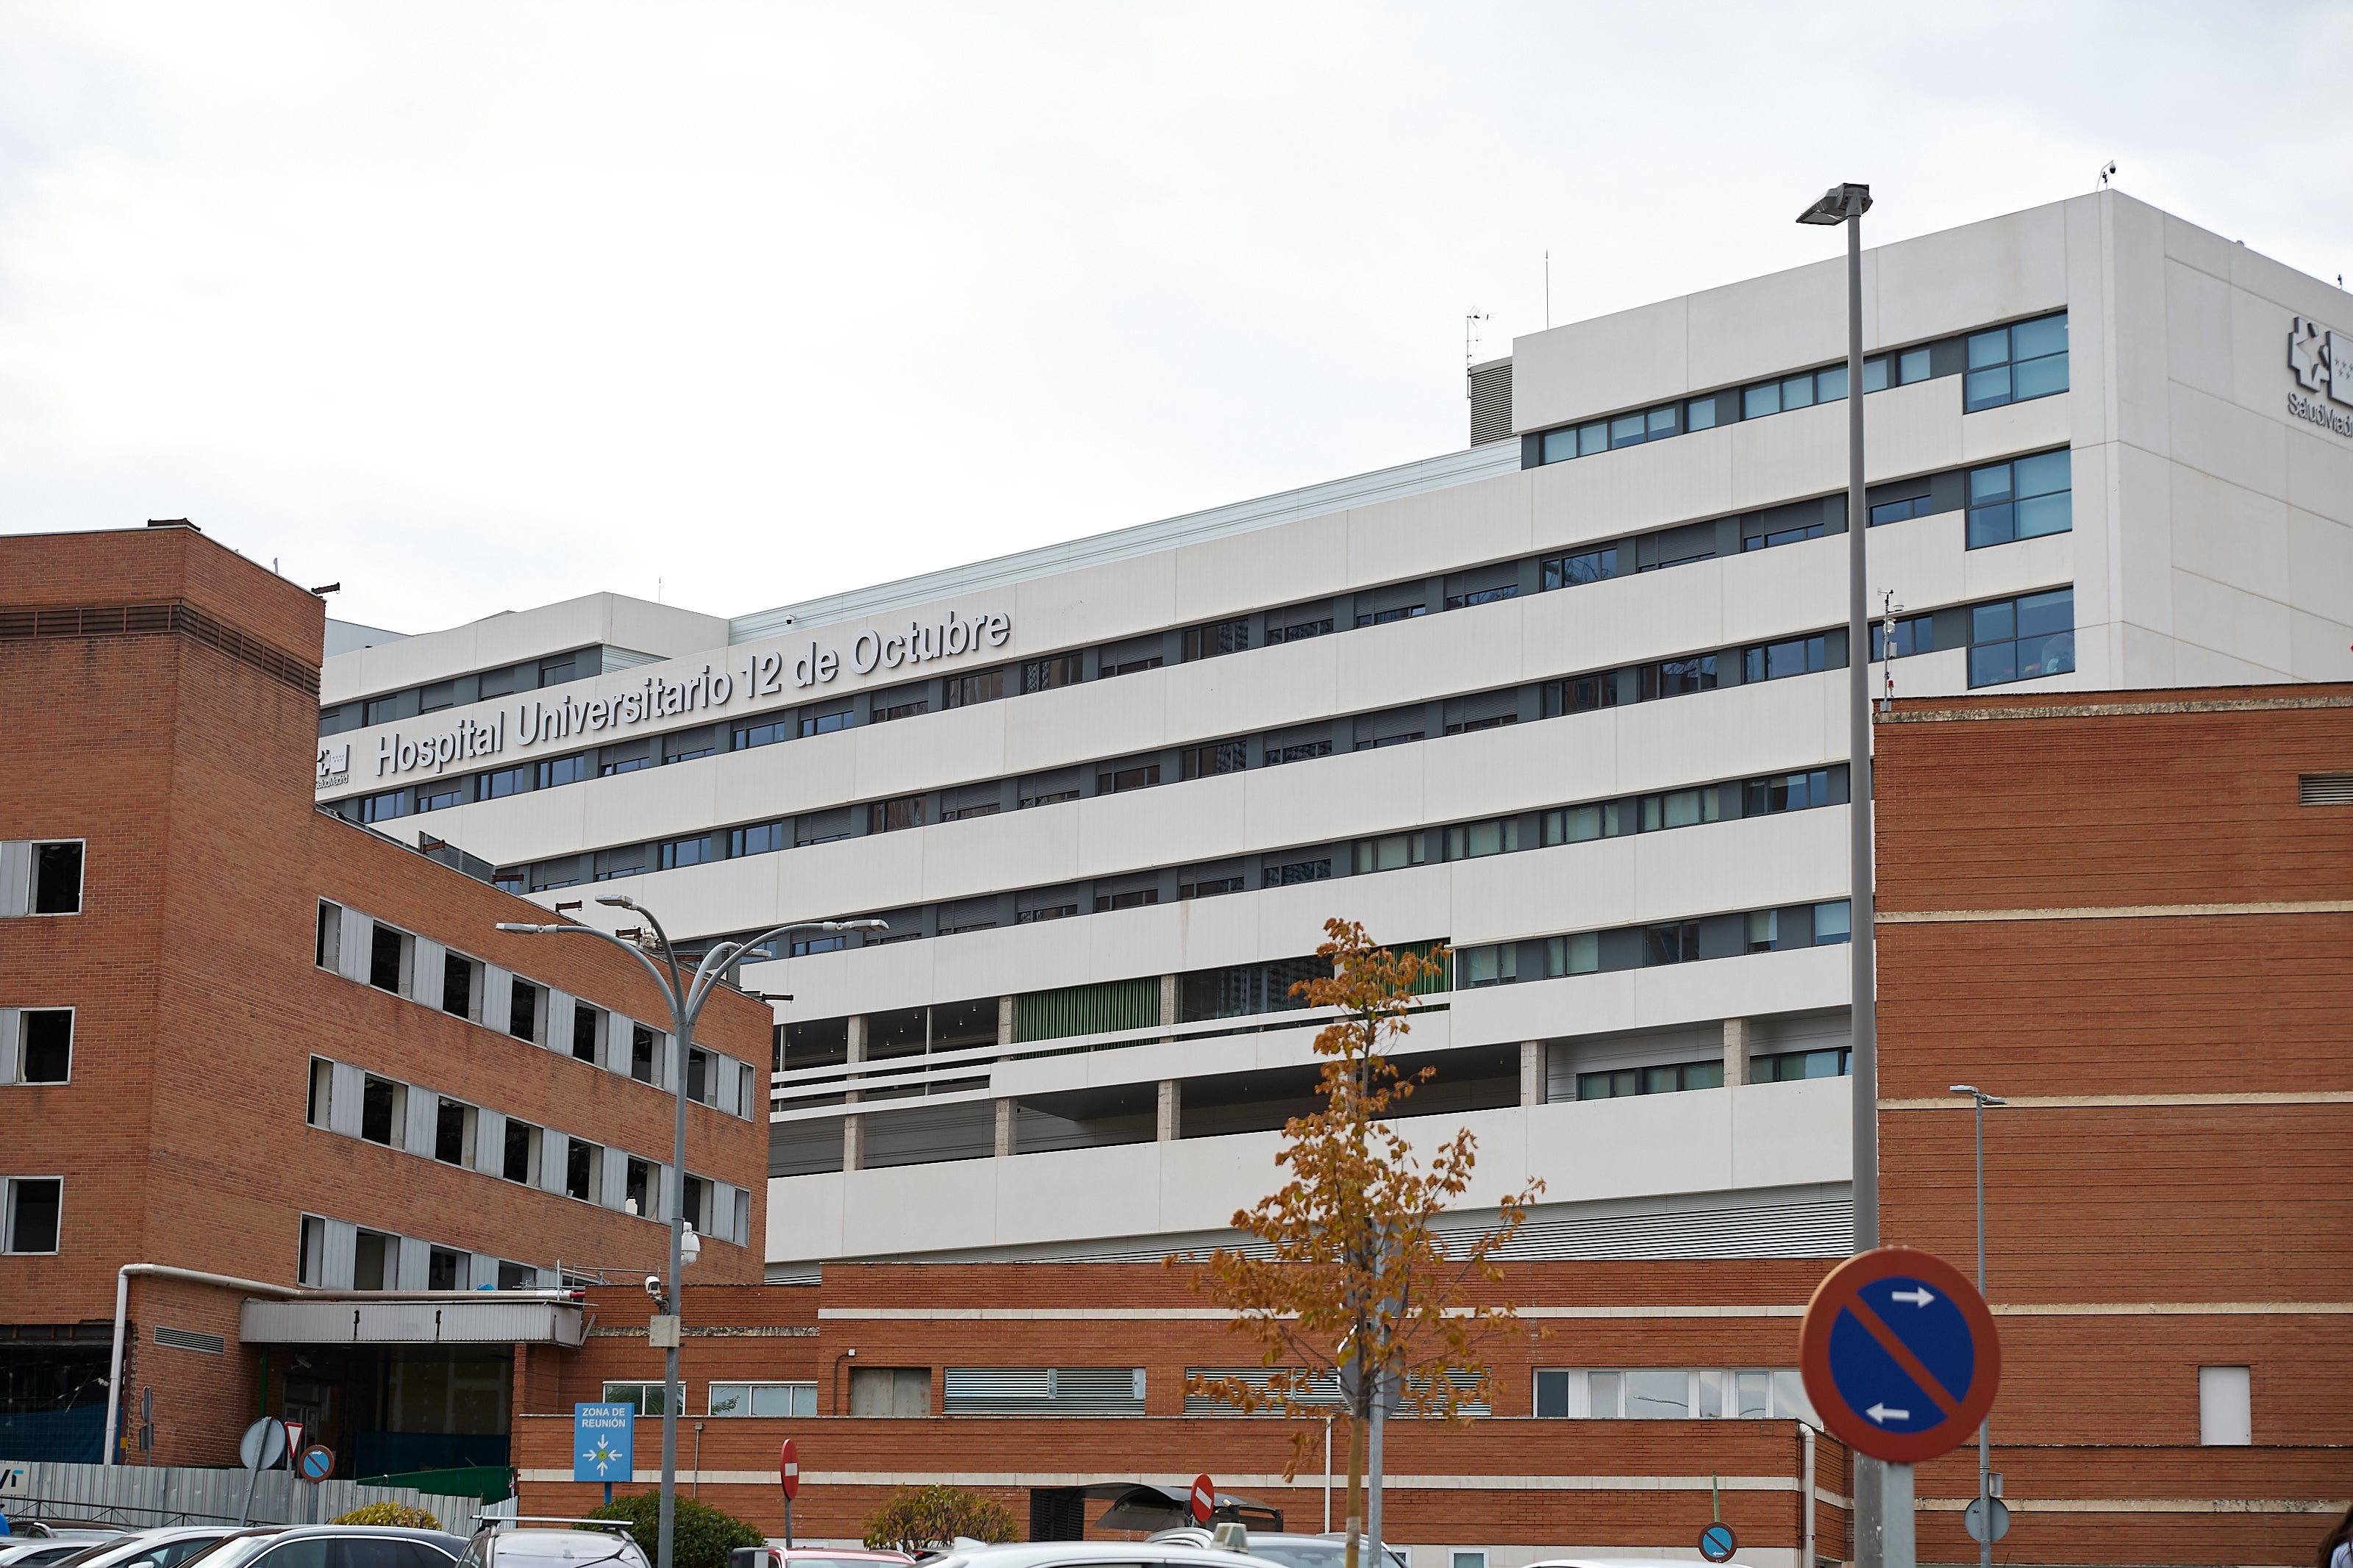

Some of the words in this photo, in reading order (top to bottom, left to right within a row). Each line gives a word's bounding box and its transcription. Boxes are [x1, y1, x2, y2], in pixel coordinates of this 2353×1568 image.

[376, 711, 504, 776] Hospital
[516, 665, 732, 745] Universitario
[740, 651, 782, 698] 12
[792, 641, 838, 688] de
[849, 611, 1011, 674] Octubre
[582, 1408, 610, 1417] ZONA
[612, 1408, 625, 1417] DE
[582, 1417, 626, 1428] REUNIÓN
